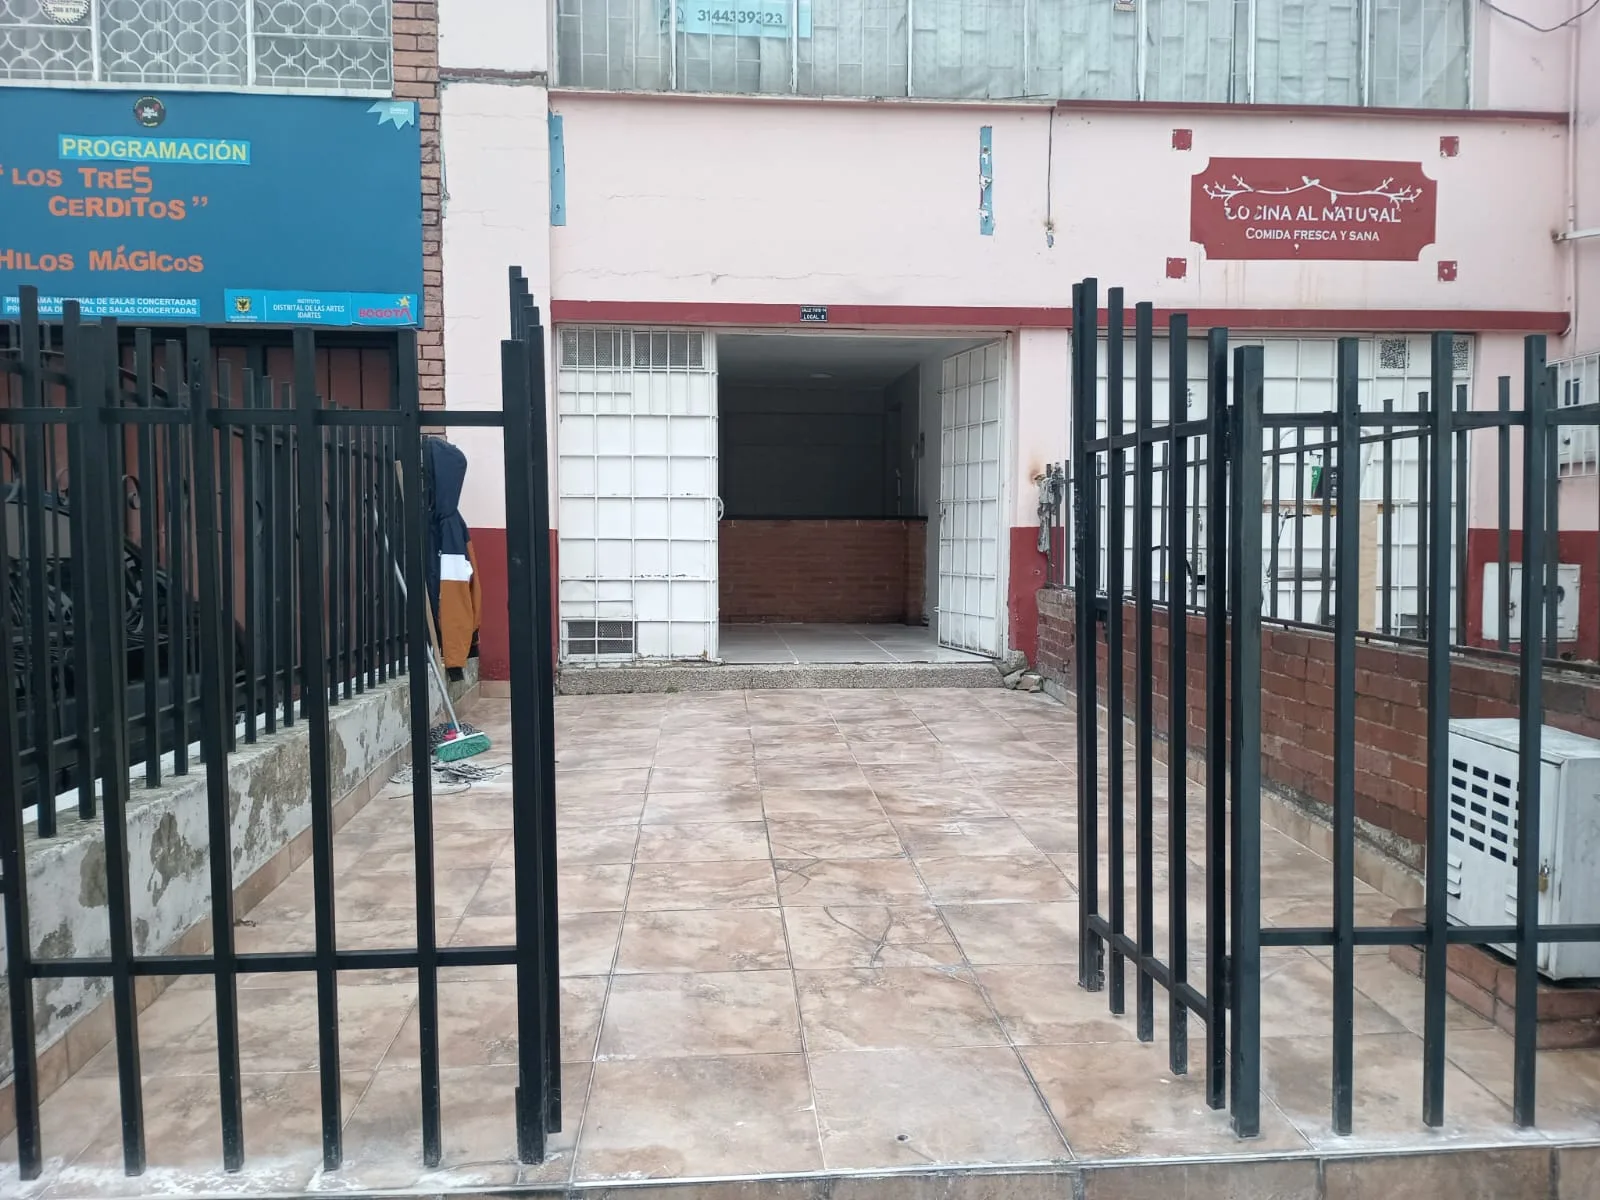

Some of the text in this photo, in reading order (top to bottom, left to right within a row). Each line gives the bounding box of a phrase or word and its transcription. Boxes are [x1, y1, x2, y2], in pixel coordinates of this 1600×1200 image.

[62, 138, 247, 161] PROGRAMACIÓN
[78, 166, 152, 194] TRES
[1296, 205, 1318, 221] AL
[1322, 205, 1402, 223] NATURAL
[1245, 227, 1380, 242] COMIDA FRESCA Y SANA
[0, 245, 204, 272] HILOS MÁGICOS
[6, 296, 53, 304] PRAMA
[54, 297, 95, 305] NANAL
[97, 297, 107, 305] DE
[137, 298, 197, 306] CONCERTADAS
[6, 305, 53, 313] PRAMA
[109, 306, 135, 314] SALAS
[137, 306, 197, 315] CONCERTADAS
